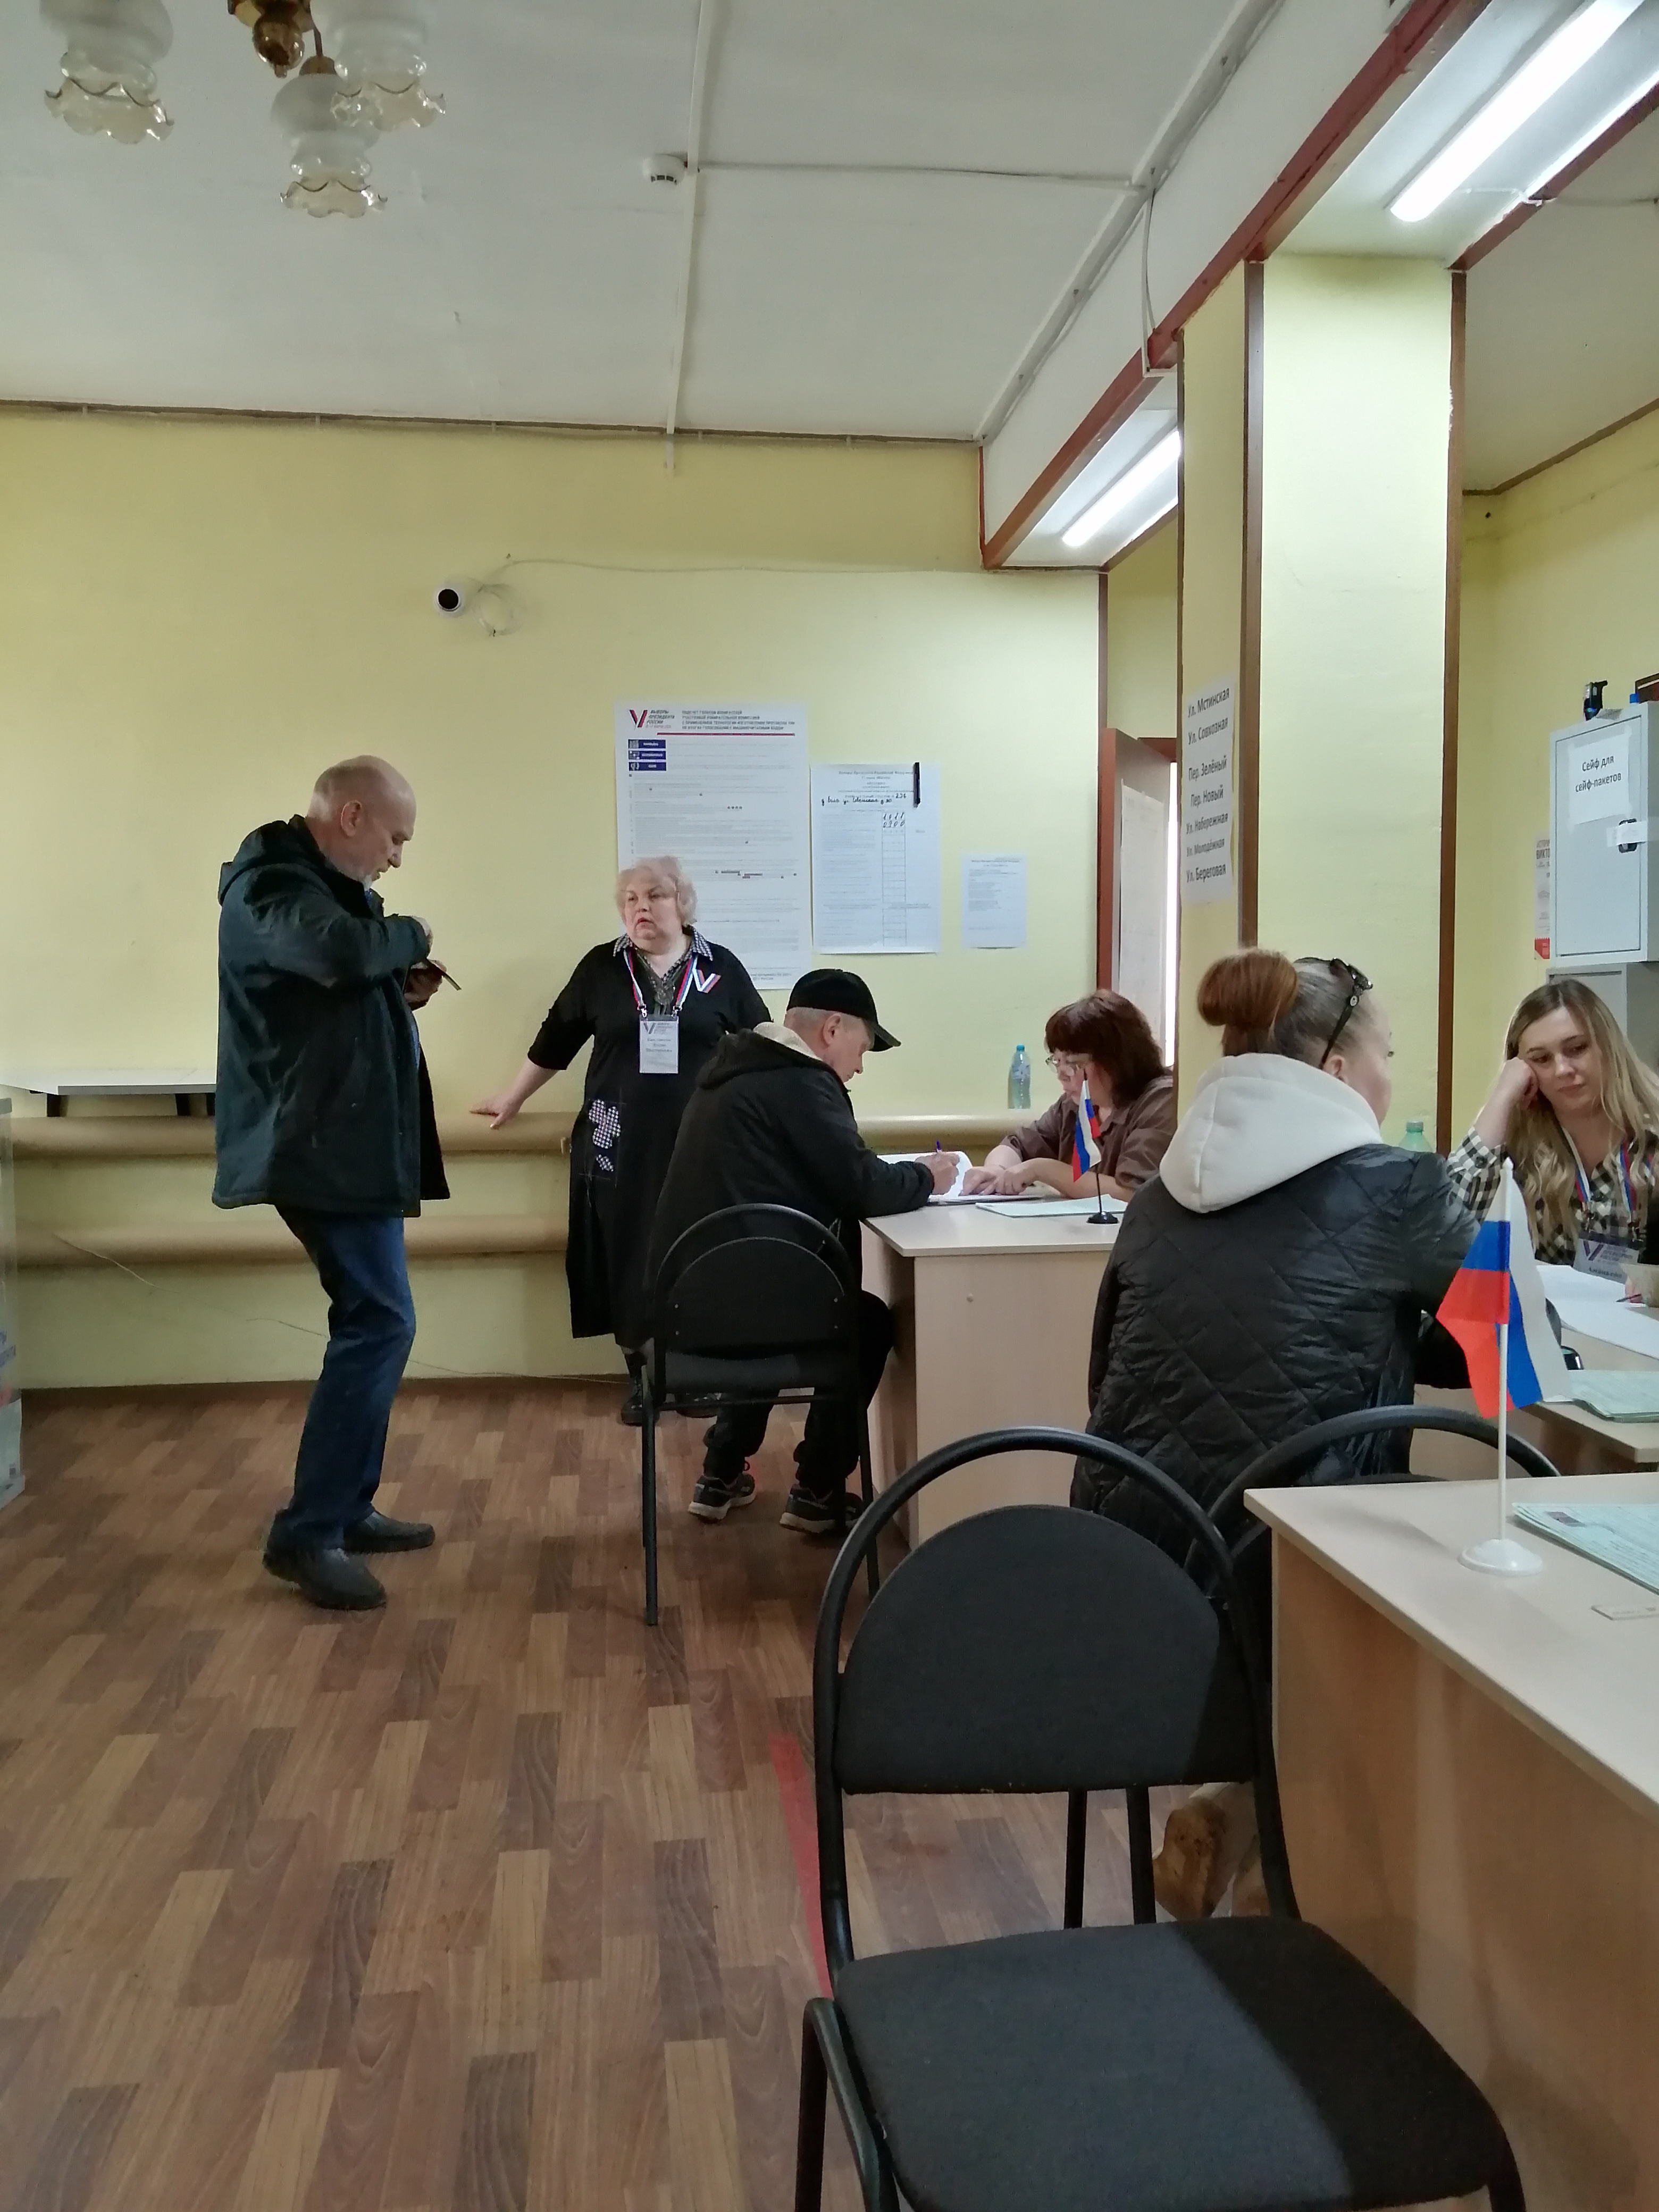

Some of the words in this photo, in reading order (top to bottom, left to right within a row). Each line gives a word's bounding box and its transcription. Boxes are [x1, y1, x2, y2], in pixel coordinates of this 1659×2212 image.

[1197, 688, 1229, 713] Мстинская
[1188, 732, 1197, 745] Ул.
[1198, 717, 1228, 740] Совхозная
[1201, 755, 1227, 777] Зелёный
[1582, 758, 1599, 772] Сейф
[1601, 756, 1614, 769] для
[1575, 773, 1621, 792] сейф-пакетов
[1203, 784, 1224, 803] Новый
[1194, 813, 1228, 832] Набережная
[1195, 864, 1226, 883] Береговая
